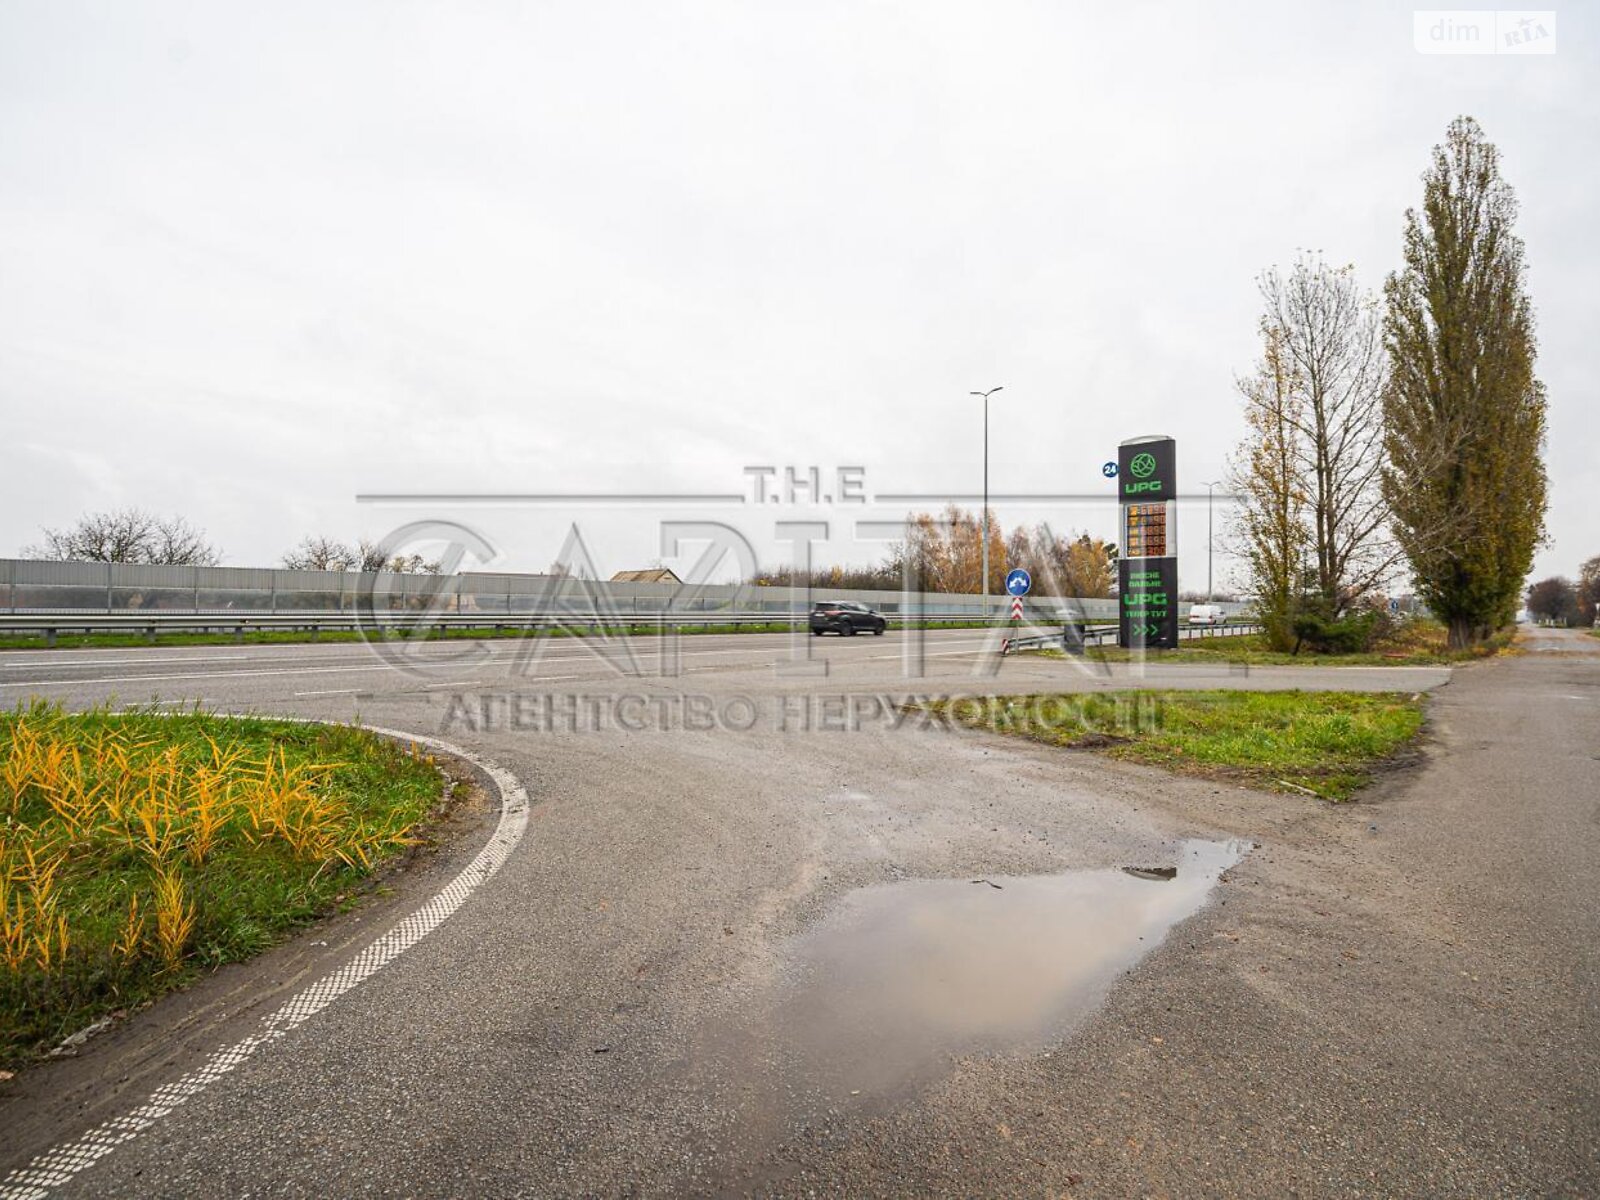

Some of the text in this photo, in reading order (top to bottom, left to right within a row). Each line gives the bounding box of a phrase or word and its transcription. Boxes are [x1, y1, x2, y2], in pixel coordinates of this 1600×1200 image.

[1104, 465, 1117, 474] 24
[1125, 481, 1162, 494] UPG
[1124, 593, 1167, 605] UPG
